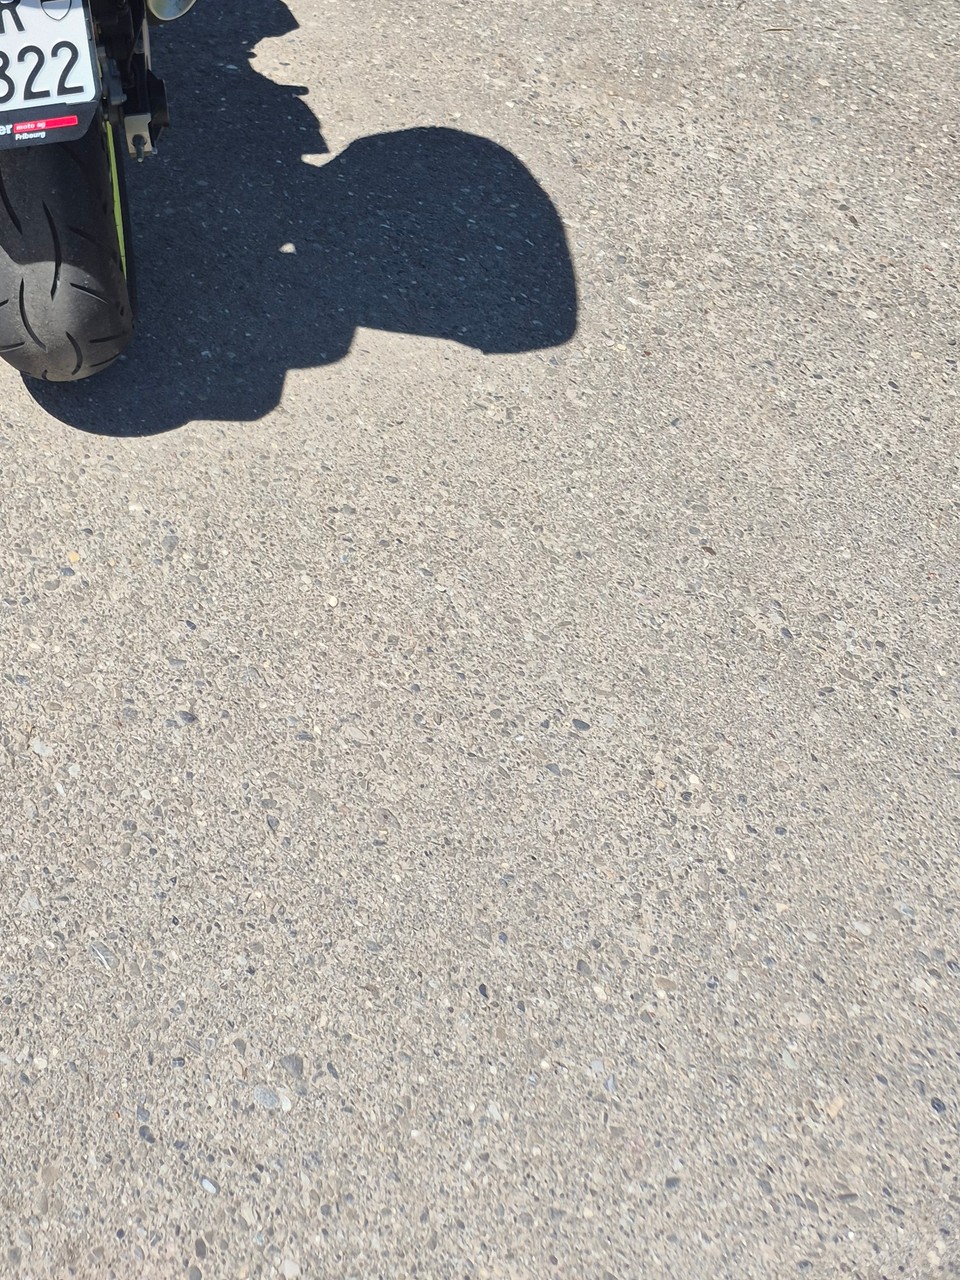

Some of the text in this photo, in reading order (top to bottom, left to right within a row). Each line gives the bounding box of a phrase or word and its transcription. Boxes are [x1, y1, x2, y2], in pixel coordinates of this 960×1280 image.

[15, 122, 35, 131] moto
[36, 121, 46, 130] ag
[14, 131, 46, 141] Fribourg
